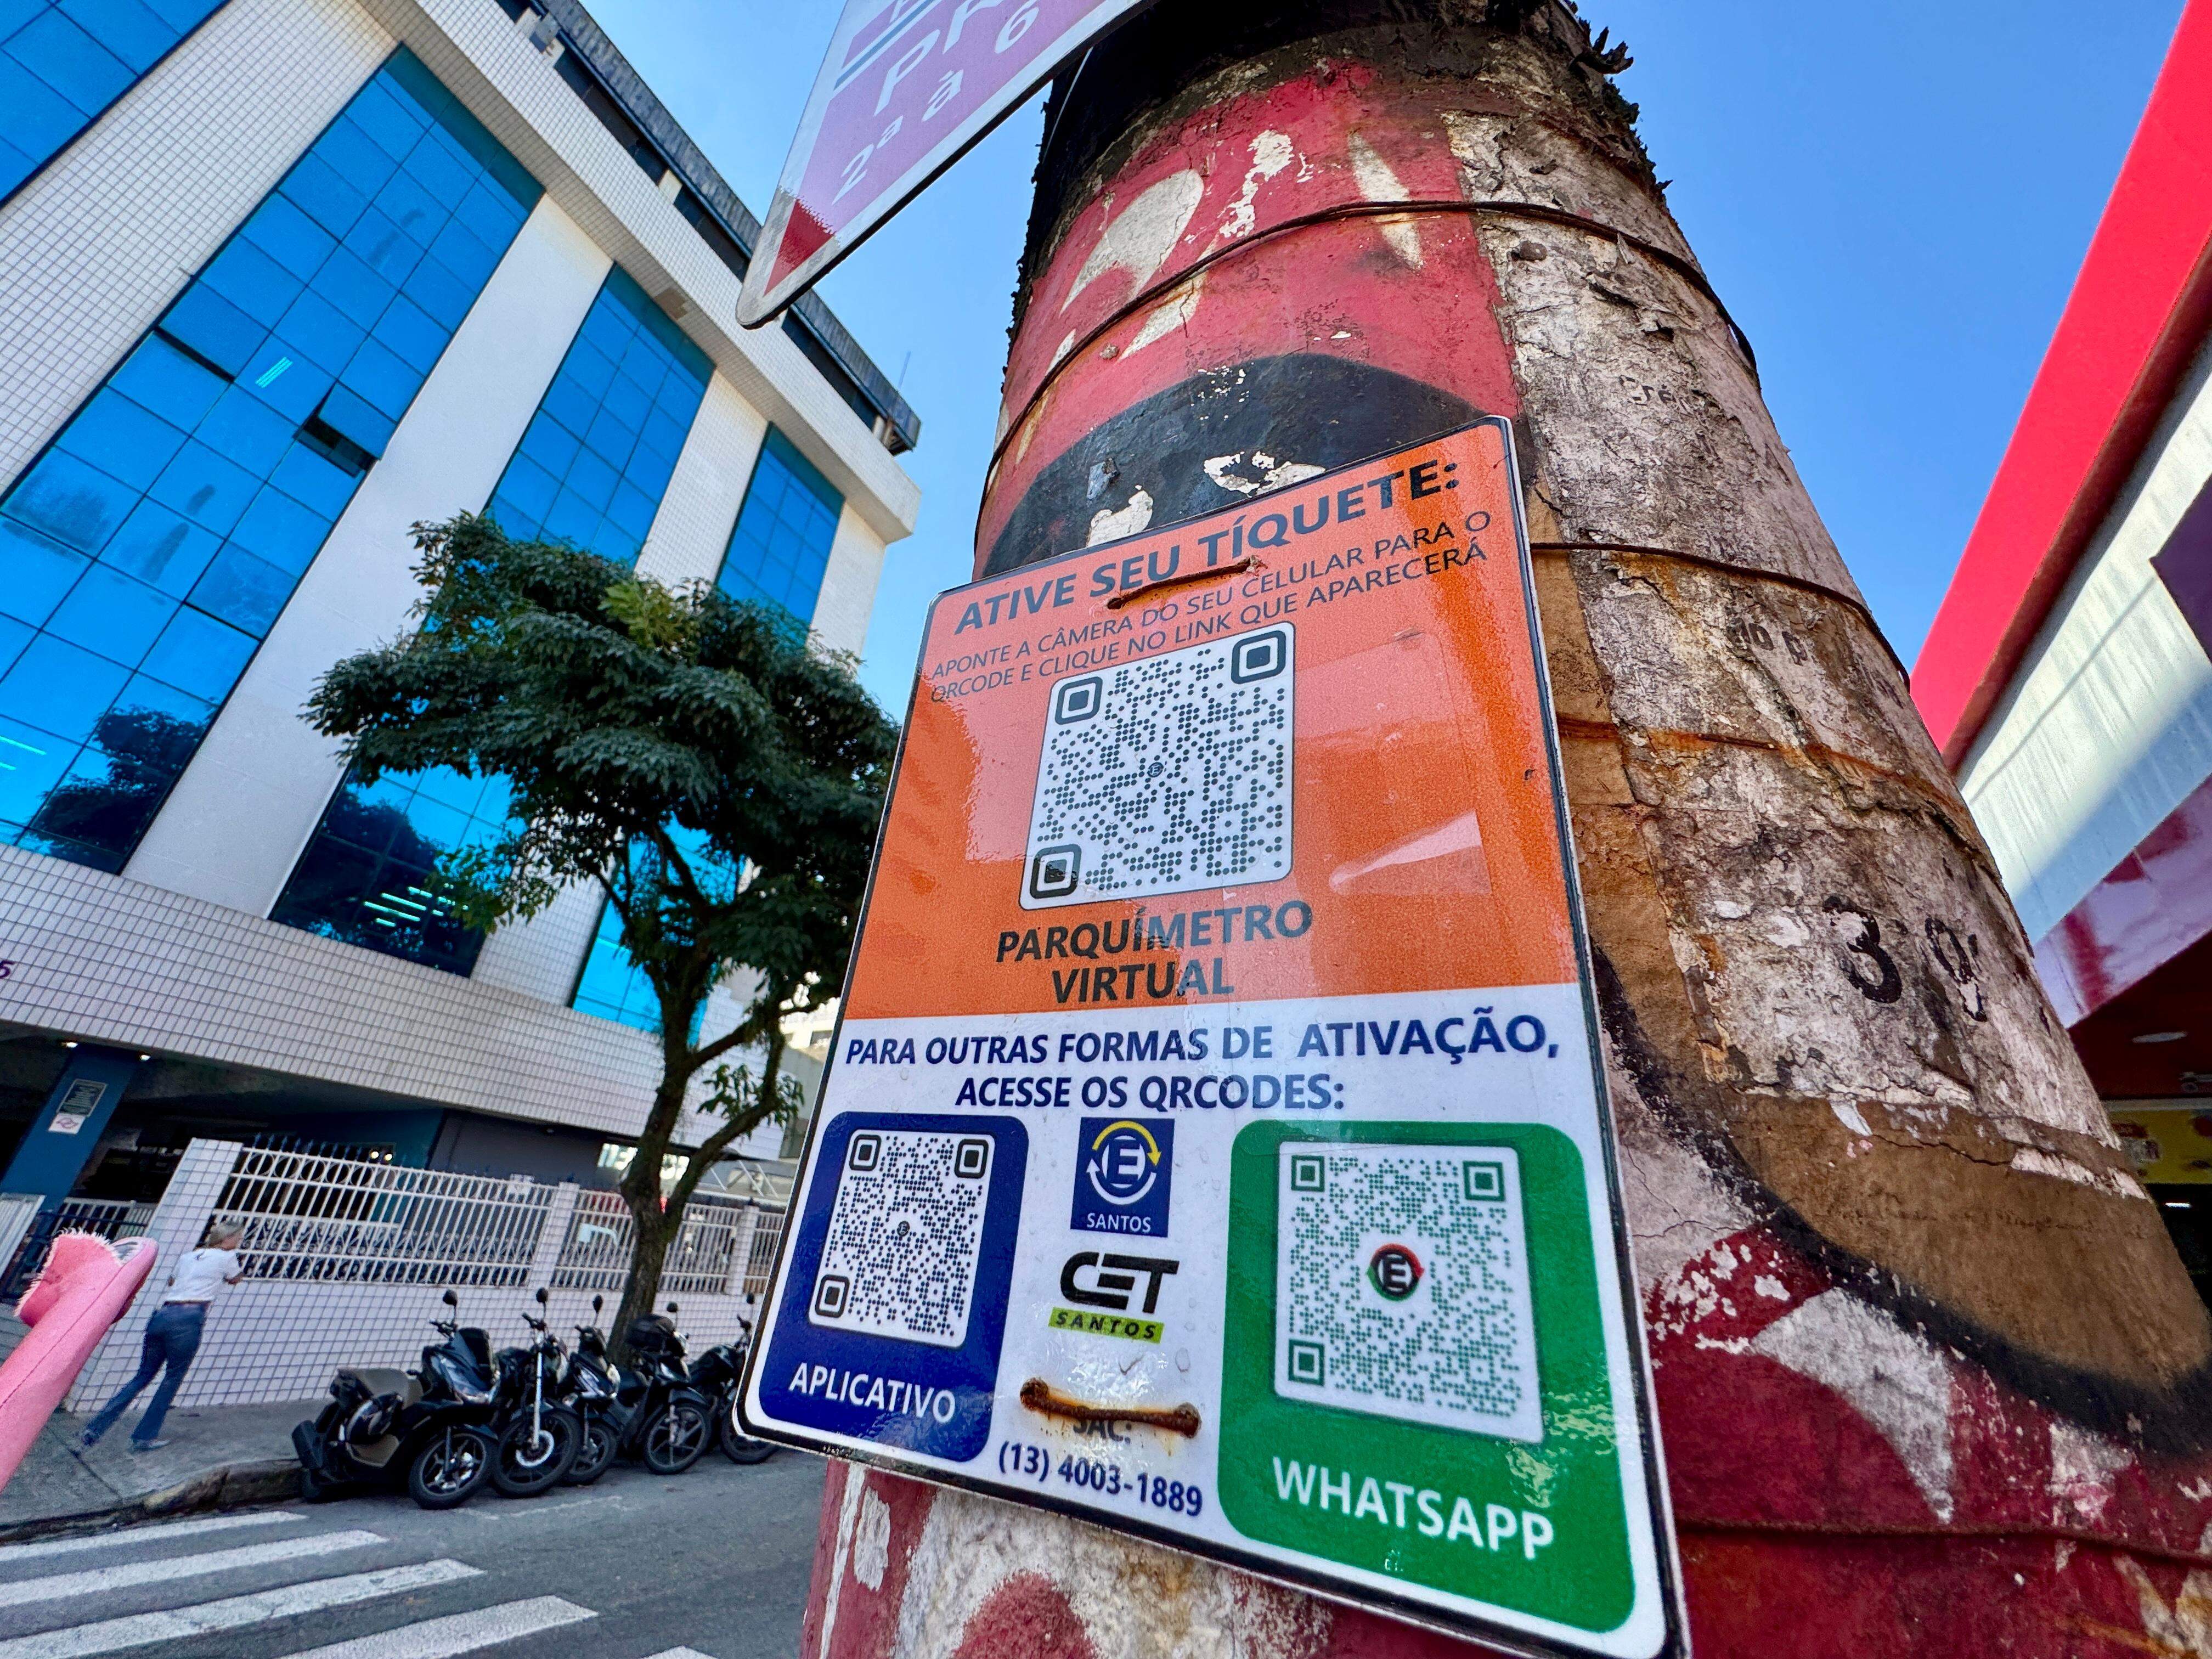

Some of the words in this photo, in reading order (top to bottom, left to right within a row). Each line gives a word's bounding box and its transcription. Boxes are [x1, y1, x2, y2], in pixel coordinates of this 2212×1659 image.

[954, 573, 1076, 635] ATIVE
[1090, 545, 1180, 597] SEU
[1198, 459, 1459, 566] TÍQUETE:
[932, 645, 1011, 680] APONTE
[1015, 640, 1031, 658] A
[1037, 615, 1132, 653] CÂMERA
[1141, 602, 1178, 628] DO
[1186, 586, 1233, 616] SEU
[1242, 548, 1364, 597] CELULAR
[1375, 521, 1455, 559] PARA
[1465, 510, 1491, 532] O
[1021, 663, 1033, 681] E
[1039, 641, 1121, 678] CLIQUE
[1128, 630, 1167, 657] NO
[1175, 613, 1231, 644] LINK
[1240, 592, 1299, 623] QUE
[1307, 537, 1487, 607] APARECERÁ
[996, 900, 1312, 963] PARQUÍMETRO
[1051, 957, 1235, 1003] VIRTUAL
[846, 1038, 916, 1064] PARA
[926, 1034, 1048, 1065] OUTRAS
[1058, 1028, 1209, 1062] FORMAS
[1222, 1025, 1273, 1059] DE
[1296, 1006, 1560, 1064] ATIVAÇÃO,
[955, 1077, 1070, 1107] ACESSE
[1081, 1076, 1128, 1108] OS
[1139, 1073, 1345, 1111] QRCODES:
[1086, 1212, 1152, 1233] SANTOS
[1060, 1251, 1180, 1314] CET
[1055, 1311, 1157, 1339] SANTOS
[788, 1362, 956, 1425] APLICATIVO
[998, 1440, 1049, 1482] (13)
[1058, 1454, 1203, 1517] 4003-1889
[1272, 1456, 1554, 1560] WHATSAPP
